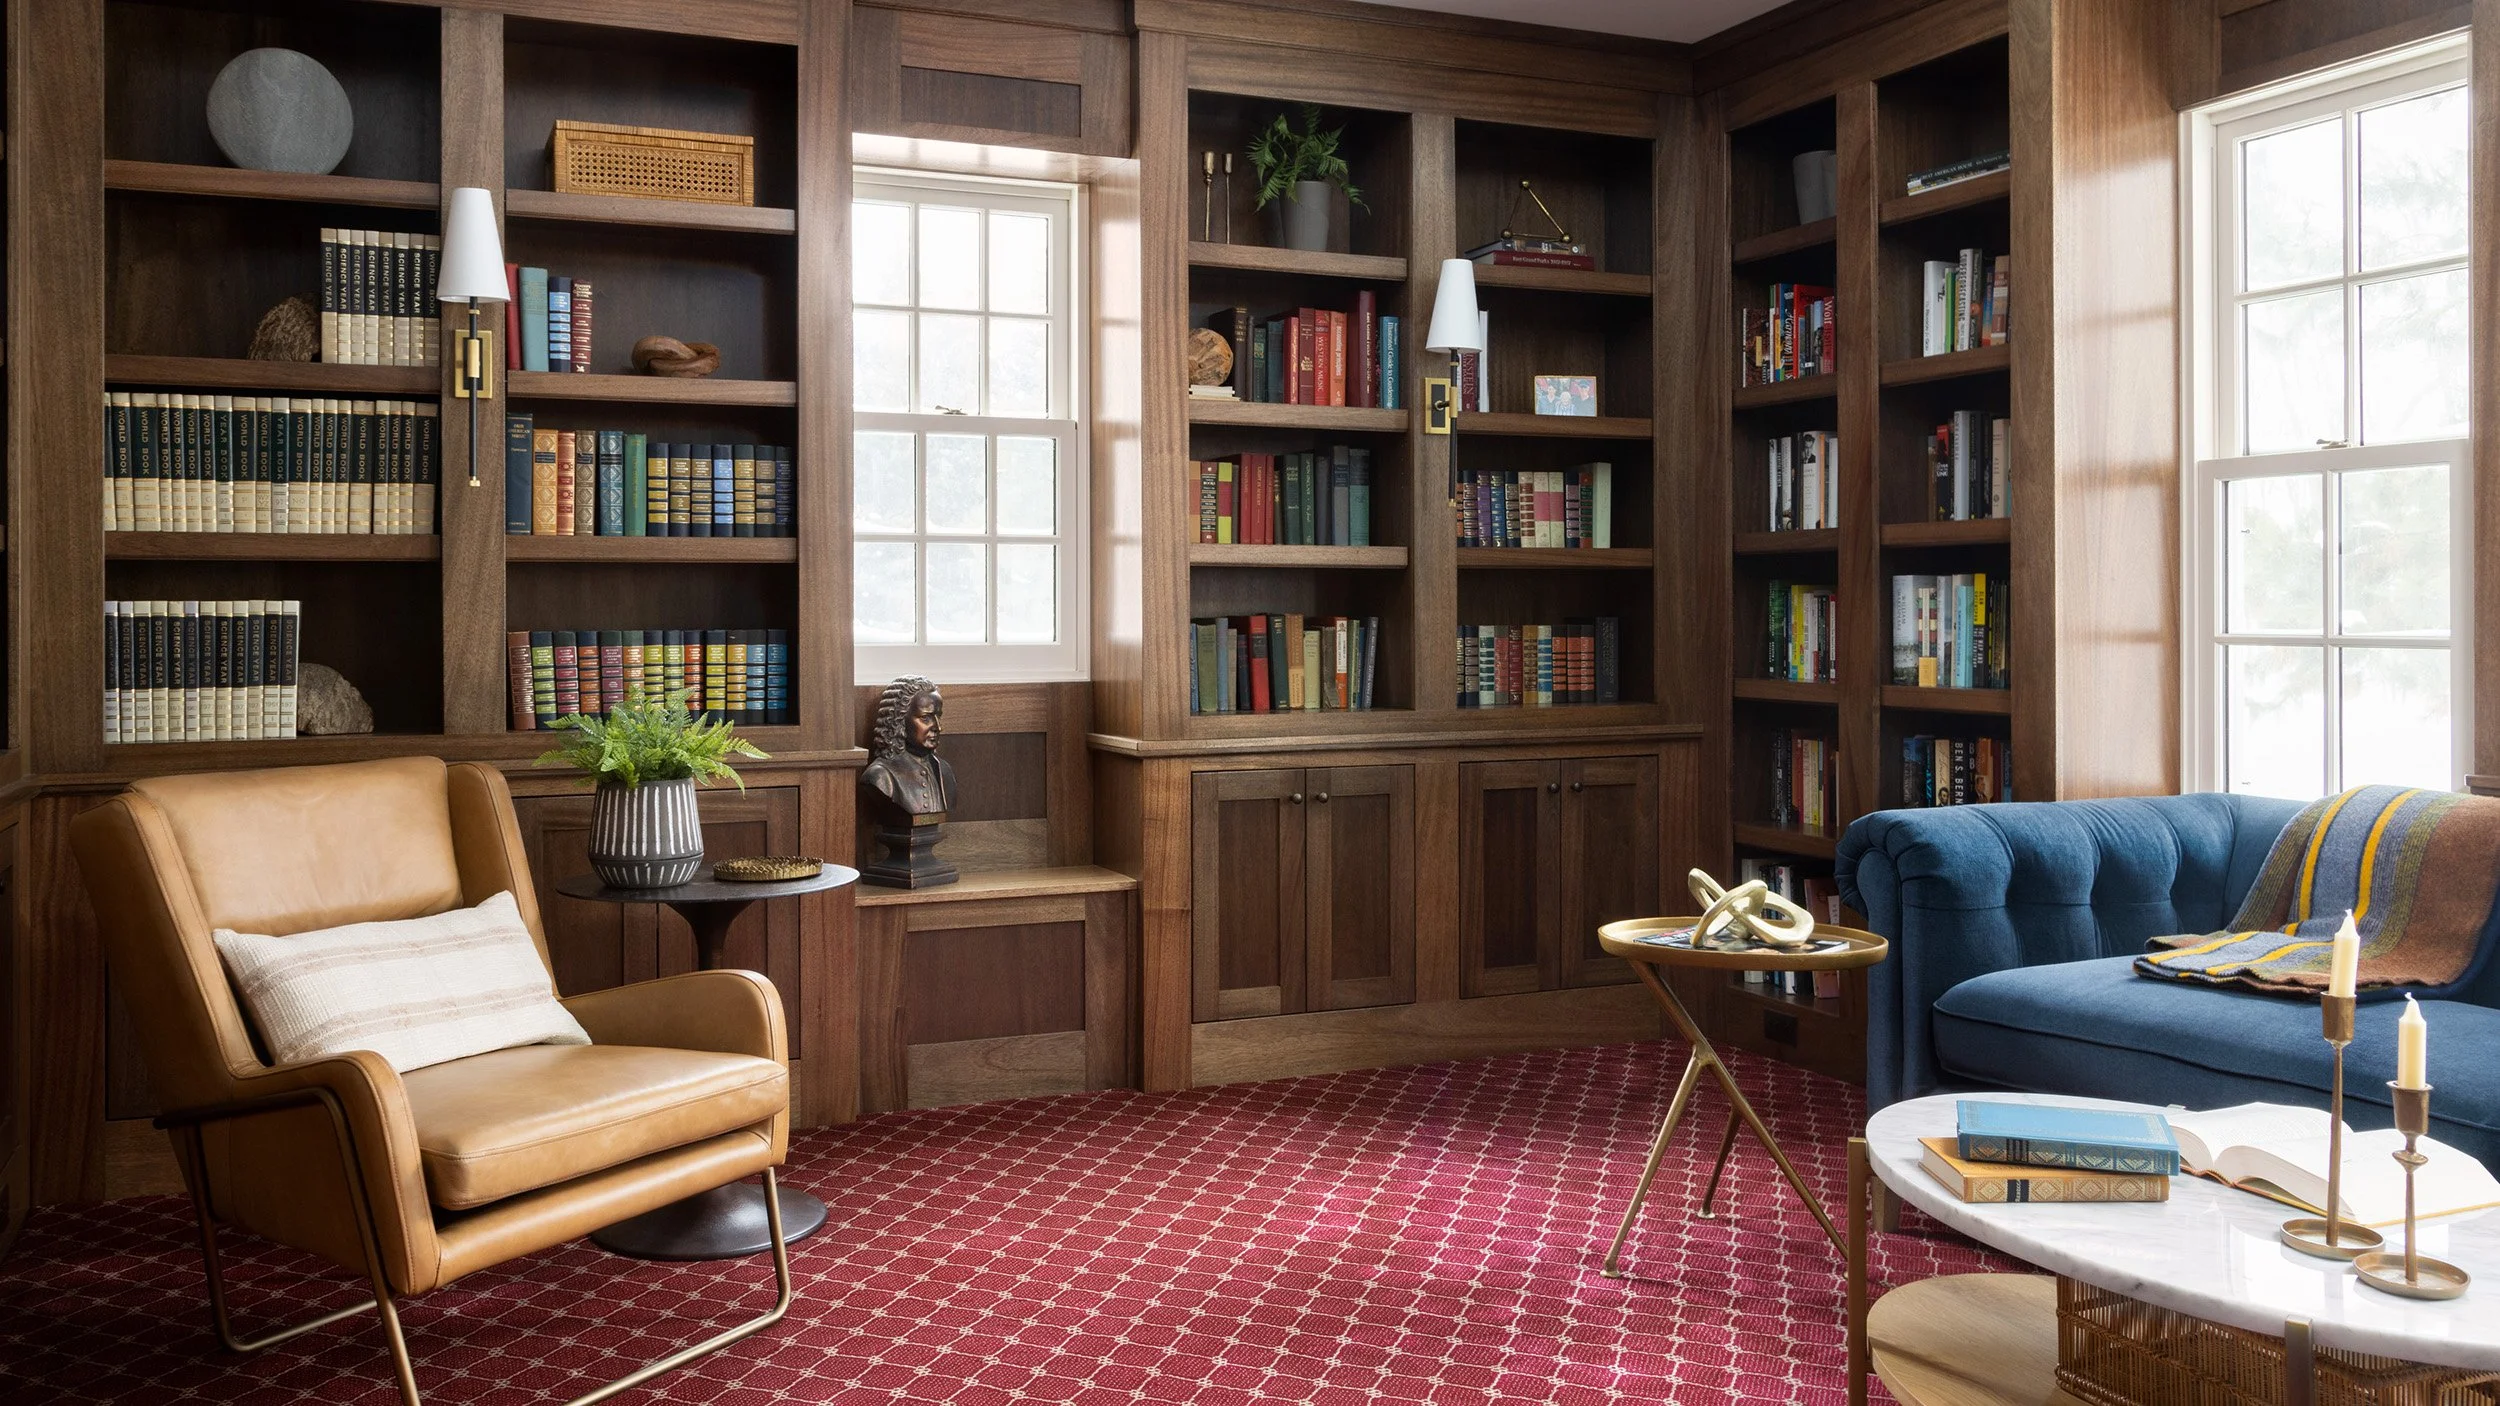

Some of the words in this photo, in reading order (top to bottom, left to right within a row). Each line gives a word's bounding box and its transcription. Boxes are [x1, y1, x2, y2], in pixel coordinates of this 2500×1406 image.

[1824, 300, 1832, 324] Wolf
[118, 410, 126, 442] WORLD
[160, 412, 169, 444] WORLD
[174, 412, 182, 444] WORLD
[188, 412, 196, 444] WORLD
[220, 415, 228, 444] YEAR
[260, 415, 268, 446] WORLD
[296, 416, 304, 448] WORLD
[312, 416, 320, 448] WORLD
[340, 418, 348, 448] WORLD
[358, 418, 366, 449] WORLD
[378, 418, 386, 449] WORLD
[422, 420, 430, 450] WORLD
[118, 448, 126, 474] BOOK
[160, 449, 169, 475] BOOK
[174, 449, 182, 476] BOOK
[188, 450, 196, 476] BOOK
[220, 450, 228, 478] BOOK
[260, 452, 268, 478] BOOK
[296, 452, 304, 478] BOOK
[312, 453, 320, 478] BOOK
[340, 454, 348, 480] BOOK
[358, 454, 366, 480] BOOK
[378, 454, 386, 480] BOOK
[422, 455, 430, 481] BOOK
[122, 622, 130, 659] SCIENCE
[138, 622, 146, 659] SCIENCE
[155, 621, 163, 657] SCIENCE
[173, 622, 181, 658] SCIENCE
[204, 620, 212, 656] SCIENCE
[220, 620, 228, 656] SCIENCE
[236, 620, 244, 656] SCIENCE
[252, 620, 260, 655] SCIENCE
[268, 620, 277, 655] SCIENCE
[285, 620, 294, 654] SCIENCE
[122, 662, 130, 686] YEAR
[138, 662, 146, 686] YEAR
[155, 662, 163, 684] YEAR
[173, 662, 181, 684] YEAR
[204, 660, 212, 684] YEAR
[220, 660, 228, 683] YEAR
[236, 660, 244, 683] YEAR
[252, 659, 260, 682] YEAR
[268, 659, 277, 682] YEAR
[285, 659, 294, 681] YEAR
[1955, 742, 1964, 762] BEN
[1955, 766, 1964, 774] S.
